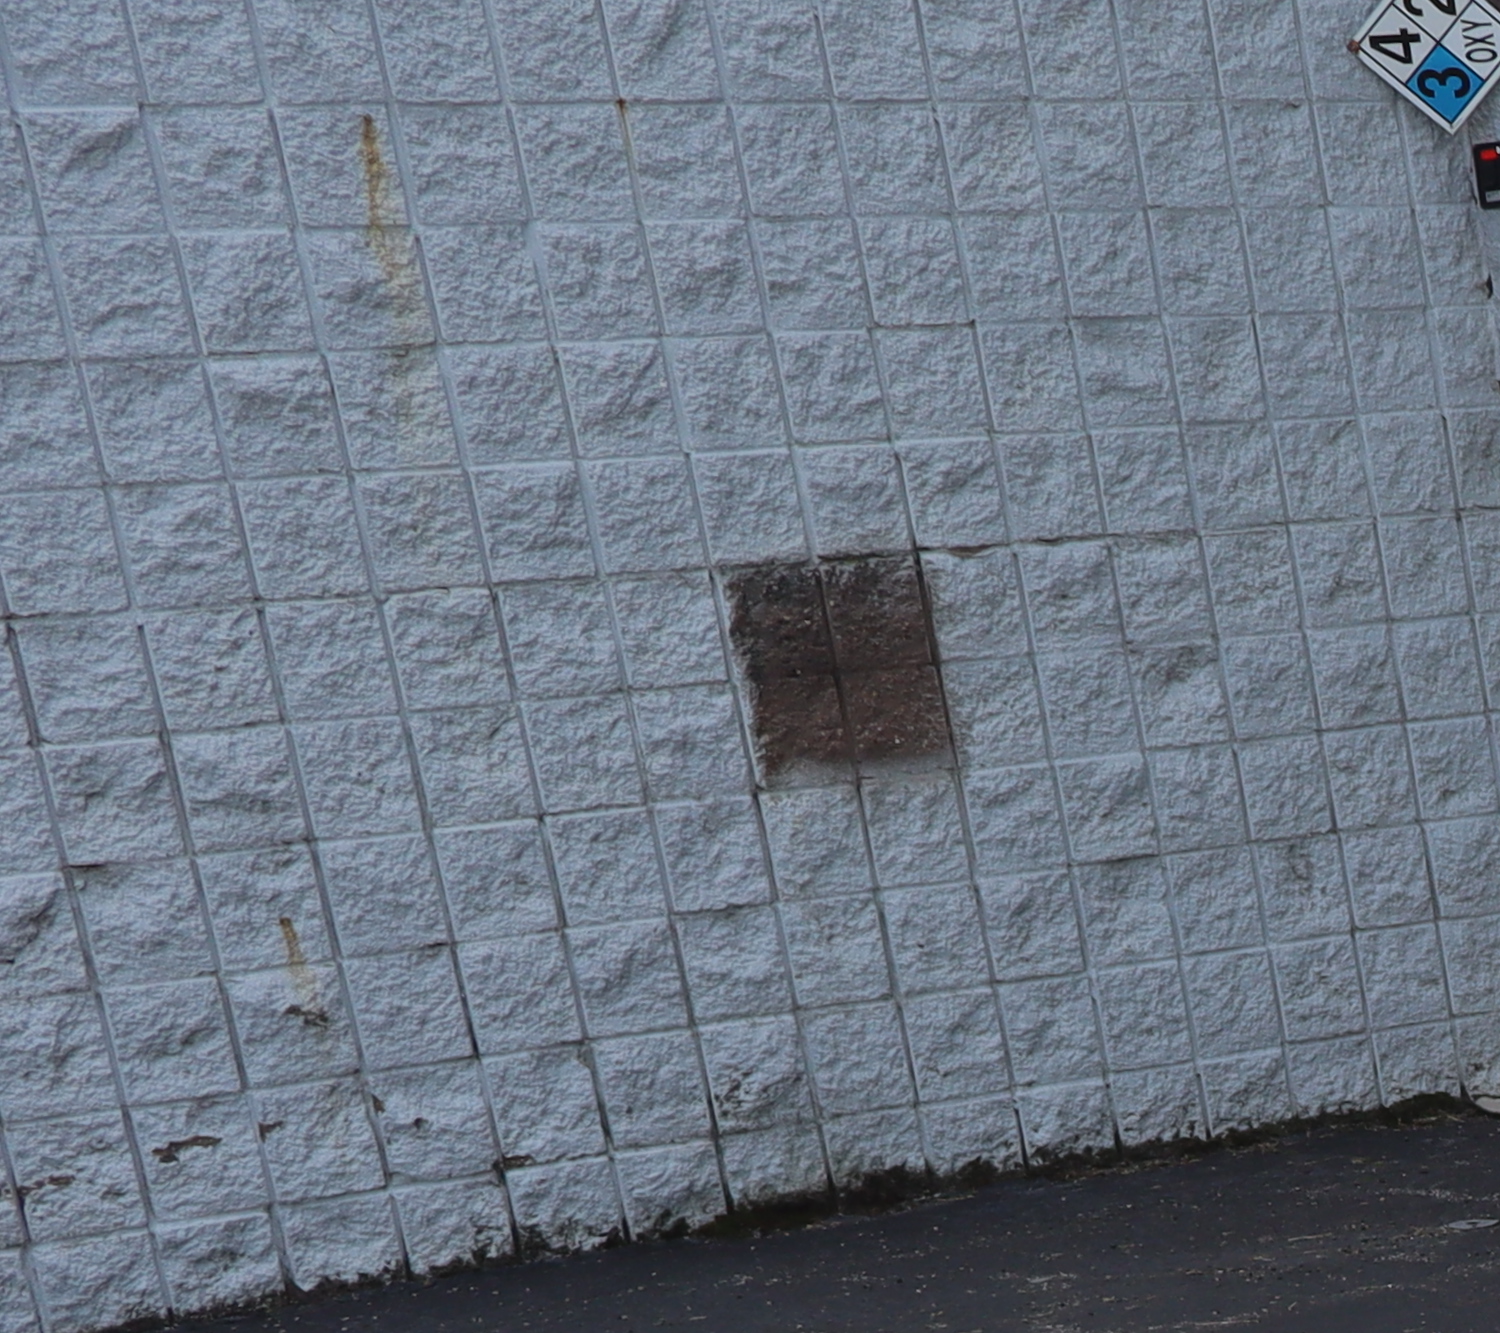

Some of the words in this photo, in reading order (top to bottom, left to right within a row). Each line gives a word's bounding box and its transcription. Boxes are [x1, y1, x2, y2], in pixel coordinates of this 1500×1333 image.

[1369, 28, 1421, 64] 4
[1460, 19, 1498, 63] OXY
[1416, 67, 1471, 98] 3
